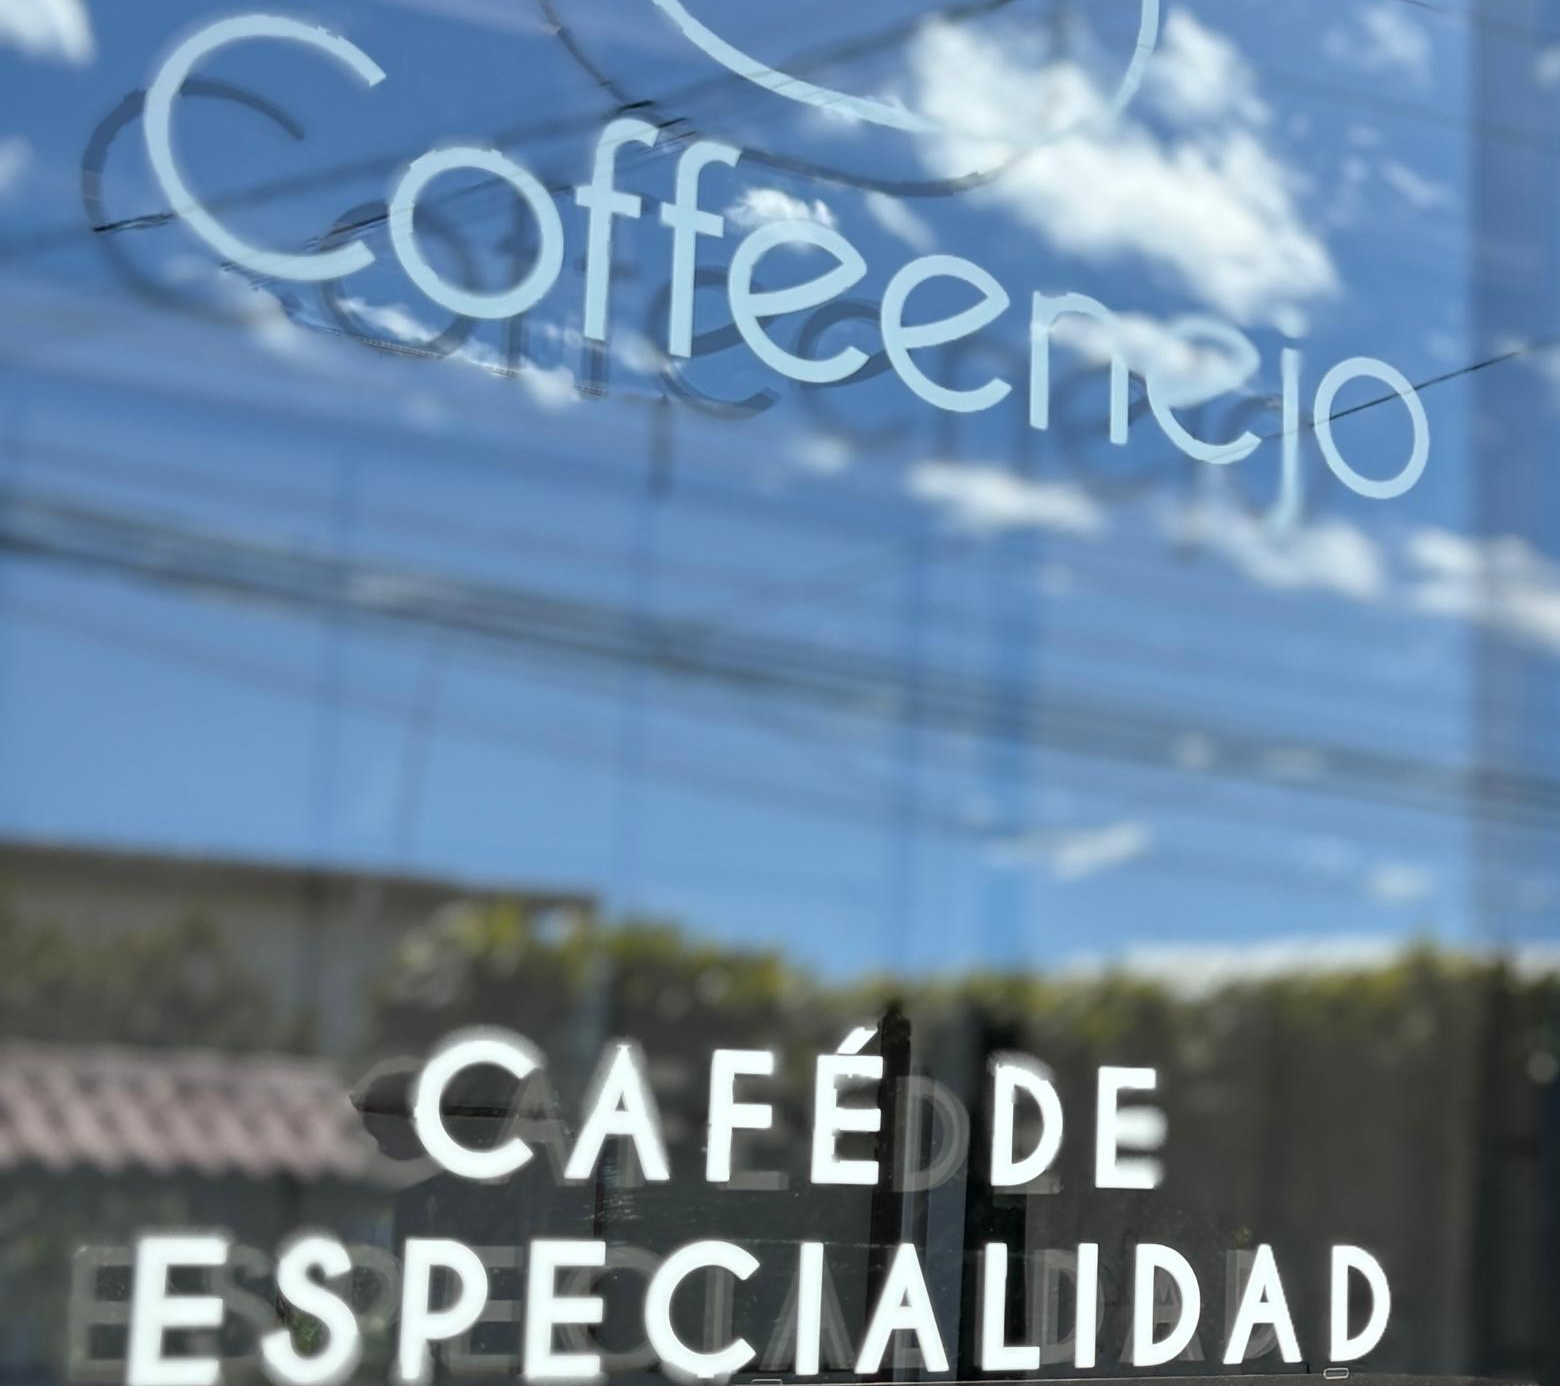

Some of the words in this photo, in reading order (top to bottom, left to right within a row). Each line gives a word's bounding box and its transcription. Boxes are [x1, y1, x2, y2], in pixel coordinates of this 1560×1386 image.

[141, 14, 1429, 533] Coffeenejo
[411, 1026, 886, 1186] CAFÉ
[988, 1054, 1168, 1192] DE
